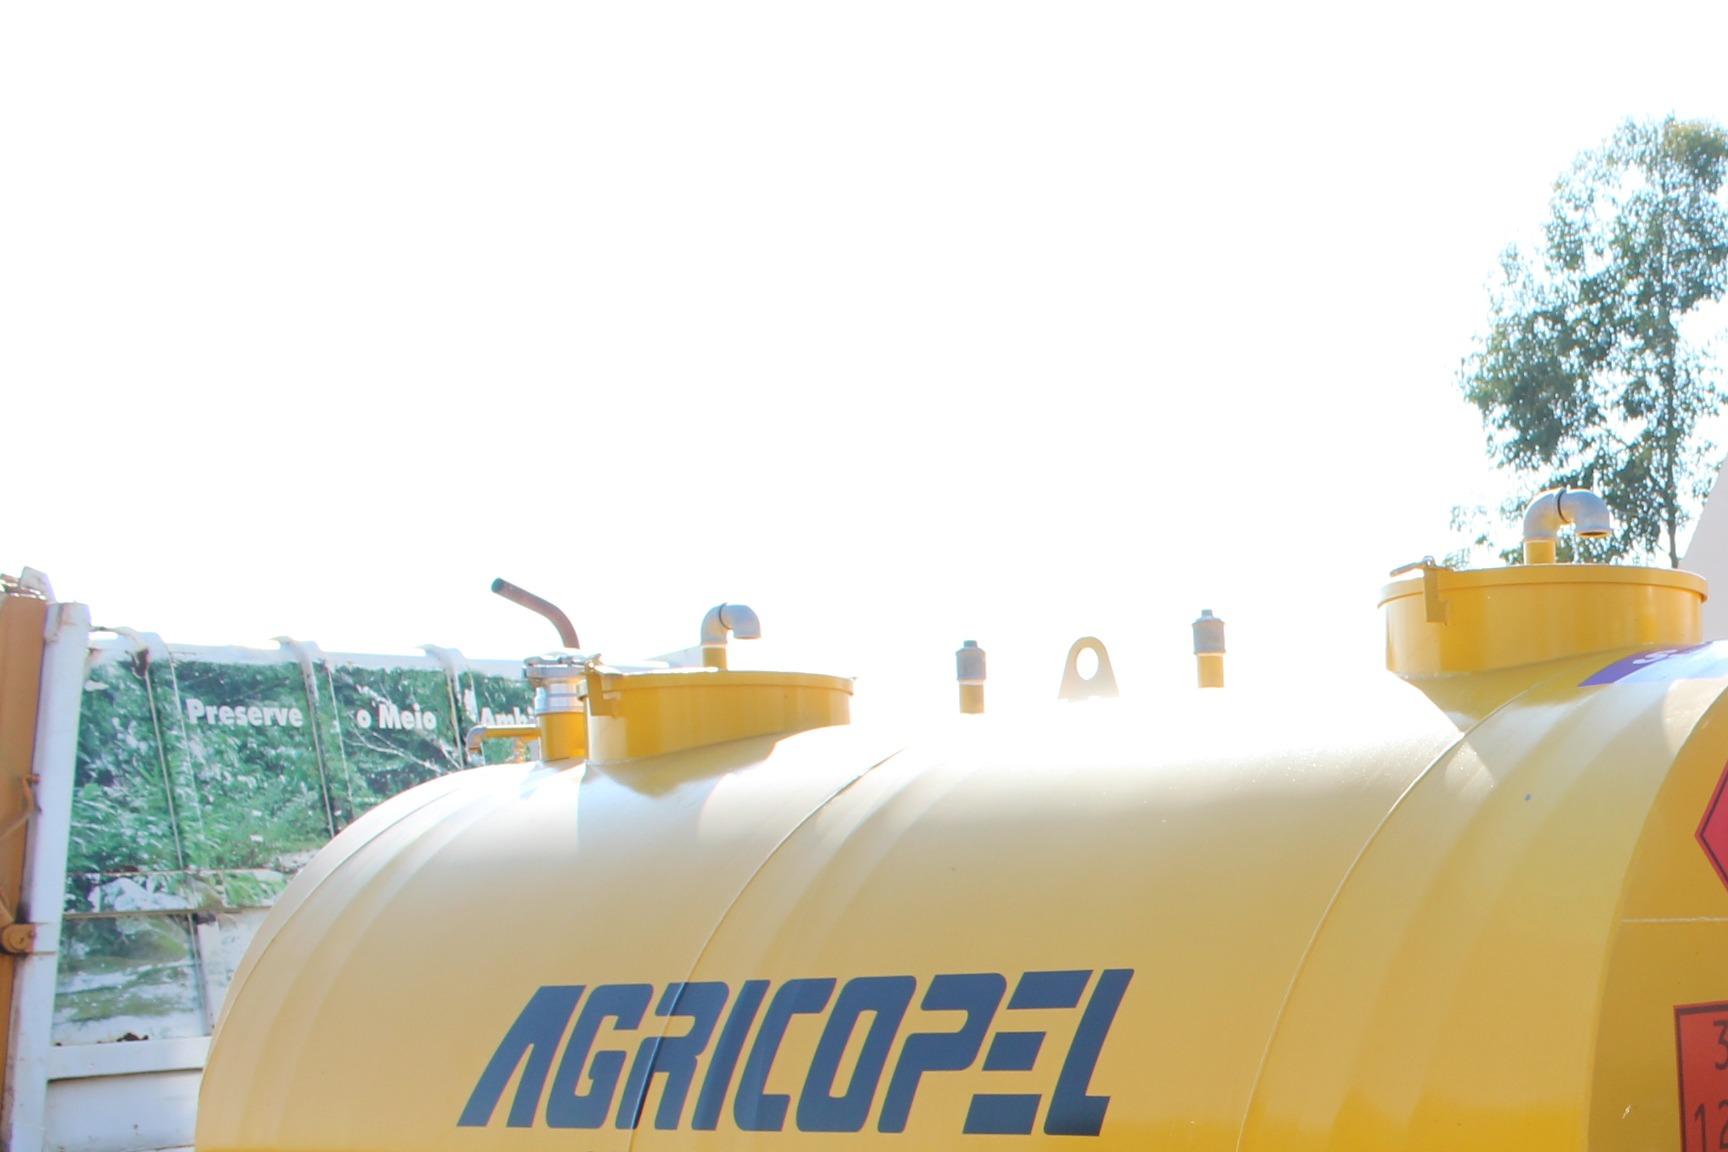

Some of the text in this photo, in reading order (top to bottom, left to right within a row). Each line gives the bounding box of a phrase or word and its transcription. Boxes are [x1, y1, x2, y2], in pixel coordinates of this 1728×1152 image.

[186, 698, 303, 727] Preserve
[356, 709, 372, 729] o
[378, 702, 437, 730] Meio
[456, 968, 1135, 1137] AGRICOPEL
